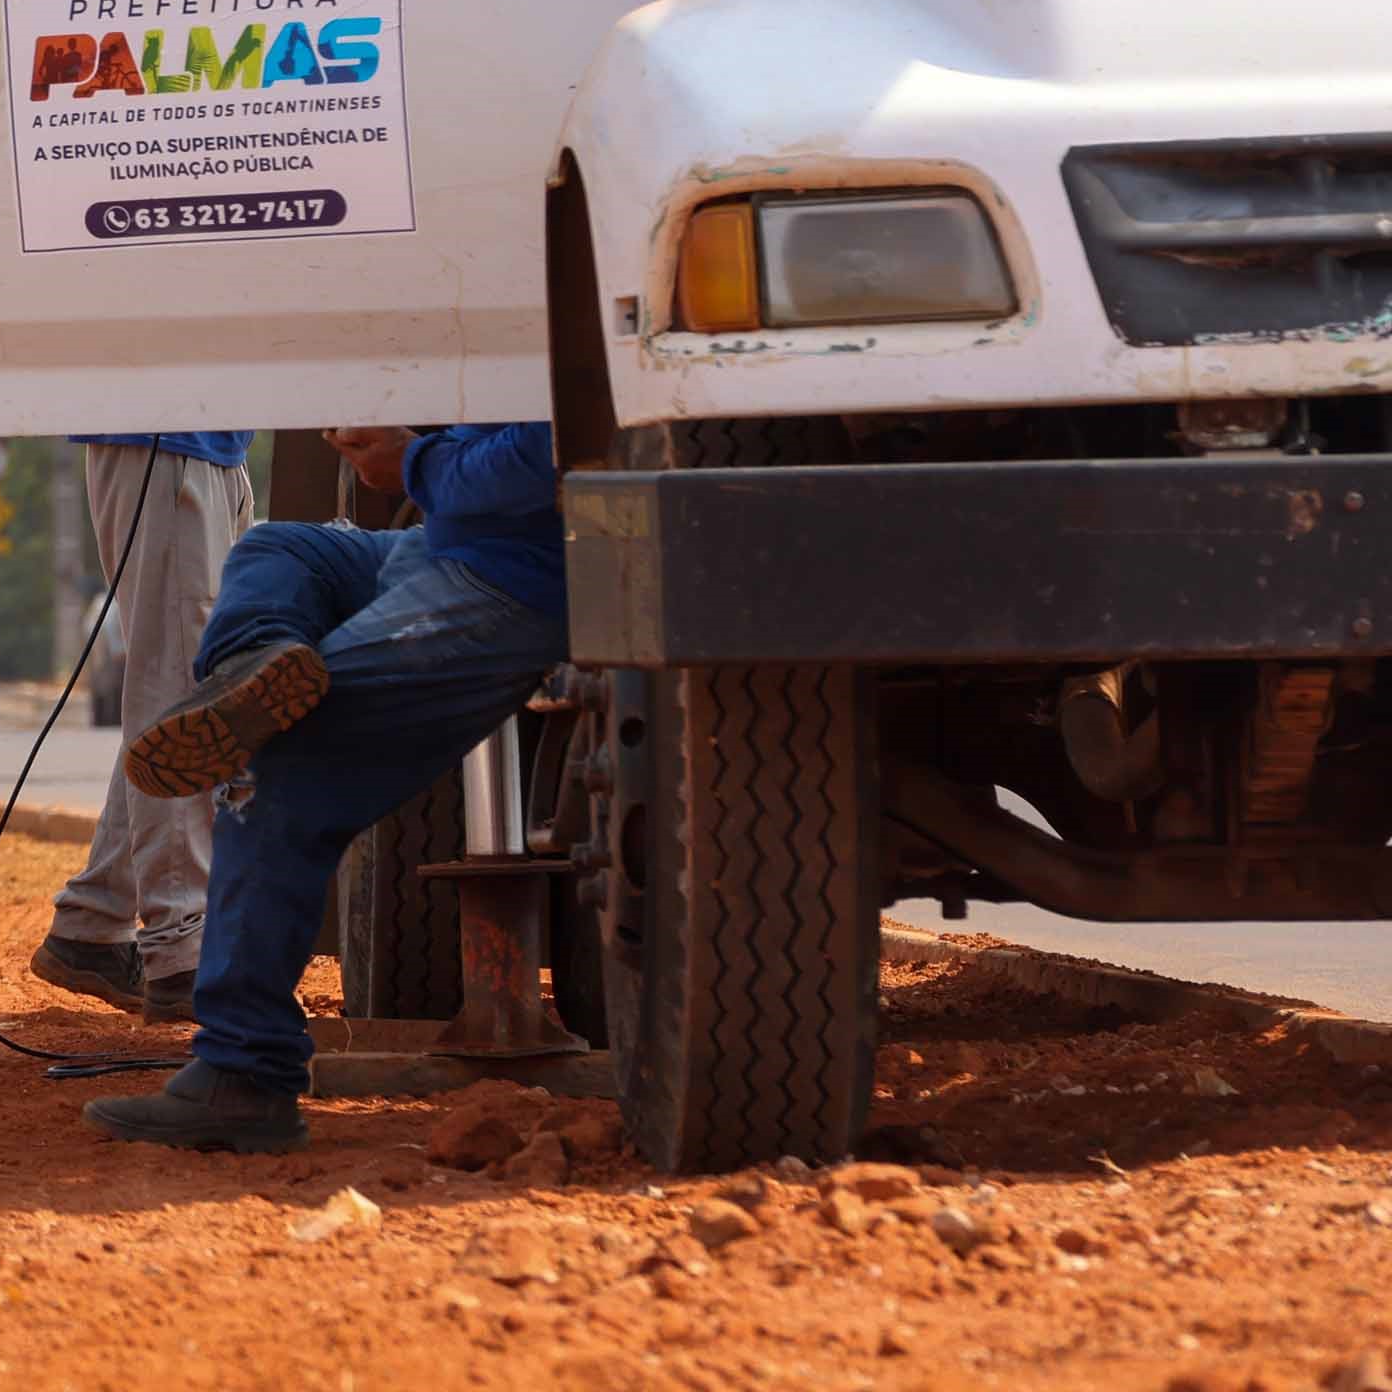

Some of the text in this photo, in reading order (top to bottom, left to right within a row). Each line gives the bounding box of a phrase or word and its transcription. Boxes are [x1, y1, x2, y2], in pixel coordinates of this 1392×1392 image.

[29, 16, 382, 102] PALMAS
[32, 95, 382, 129] A CAPITAL DE TODOS OS TOCANTINENSES
[33, 127, 388, 162] A SERVIÇO DA SUPERINTENDÊNCIA DE
[110, 153, 314, 181] ILUMINAÇÃO PÚBLICA
[134, 198, 327, 230] 63 3212-7417
